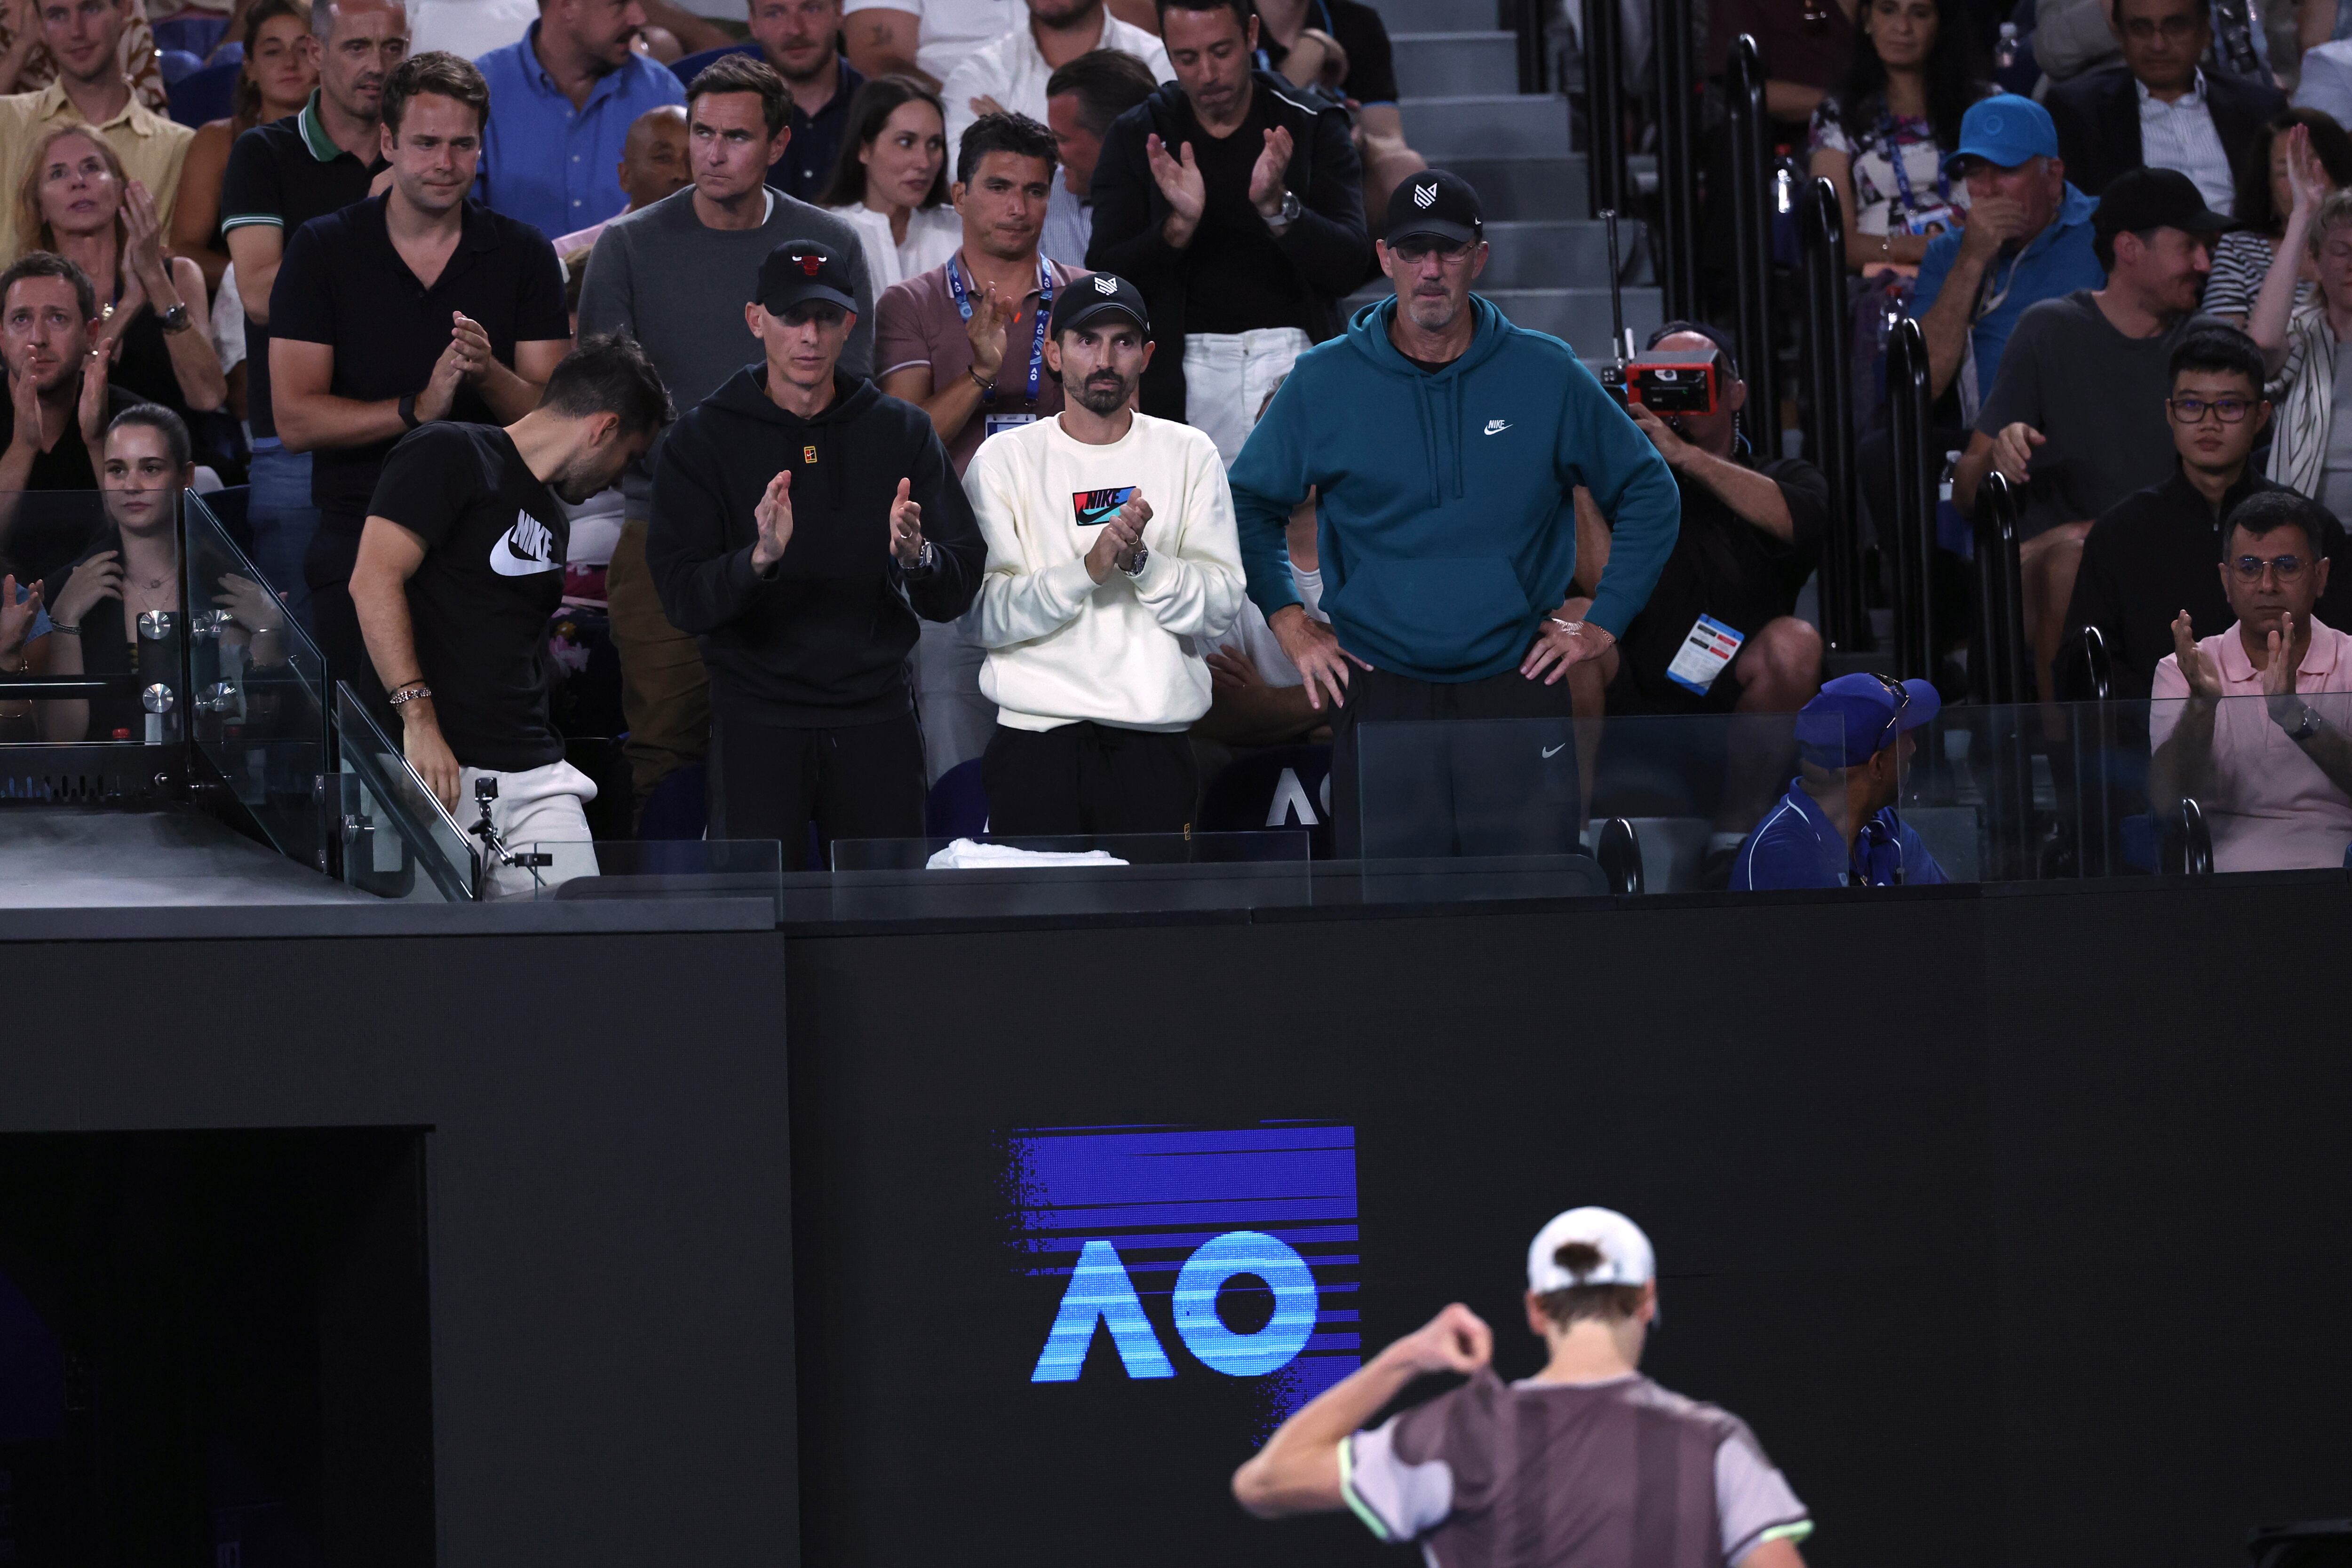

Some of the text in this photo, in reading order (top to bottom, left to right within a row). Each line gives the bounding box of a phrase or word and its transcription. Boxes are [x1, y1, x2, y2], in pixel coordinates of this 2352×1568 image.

[1036, 323, 1044, 335] AO
[1030, 368, 1038, 380] AO
[1488, 420, 1505, 429] NIKE
[1085, 490, 1121, 509] NIKE
[510, 508, 553, 563] NIKE
[1265, 768, 1330, 826] A
[1031, 1231, 1318, 1383] AO
